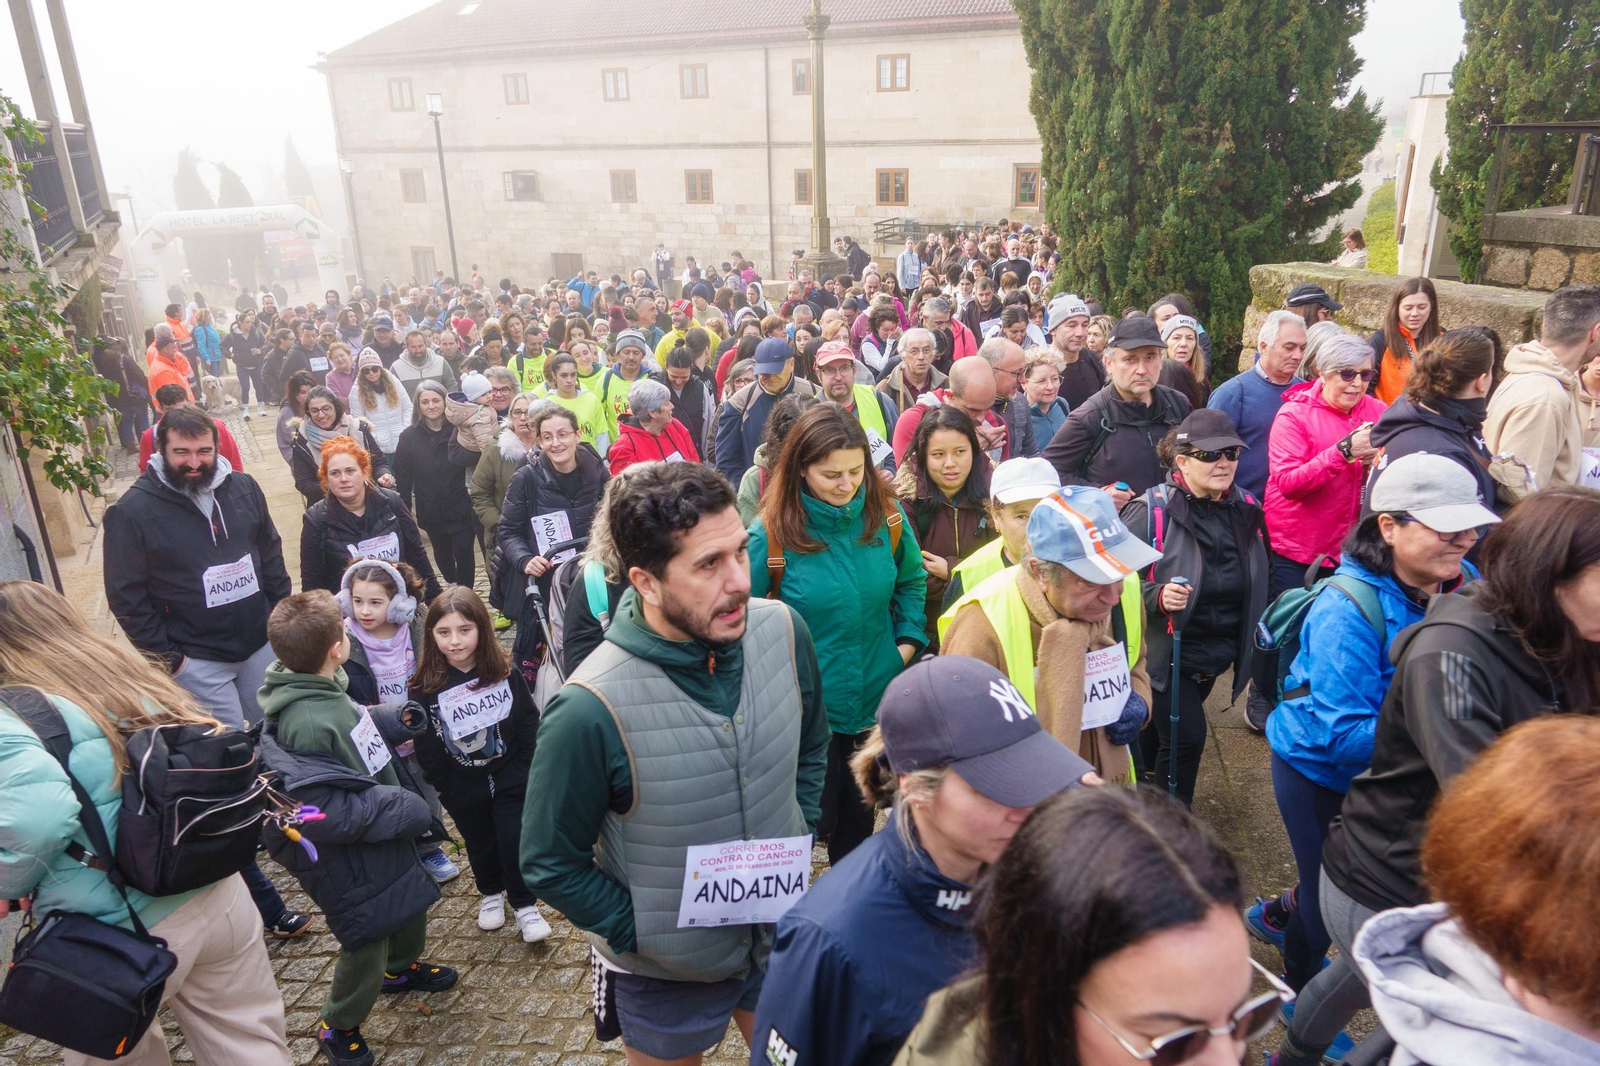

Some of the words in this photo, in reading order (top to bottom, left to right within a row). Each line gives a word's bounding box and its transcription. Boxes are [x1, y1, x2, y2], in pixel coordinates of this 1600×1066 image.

[169, 217, 208, 228] HOTEL
[212, 215, 227, 226] LA
[209, 572, 255, 596] ANDAINA
[1088, 654, 1122, 670] CANCRO
[453, 688, 511, 723] ANDAINA
[989, 678, 1034, 723] NY
[700, 854, 743, 867] CONTRA
[746, 853, 755, 861] O
[758, 849, 803, 861] CANCRO
[720, 843, 786, 855] CORREMOS
[744, 861, 772, 870] FEBREIRO
[693, 870, 804, 903] ANDAINA
